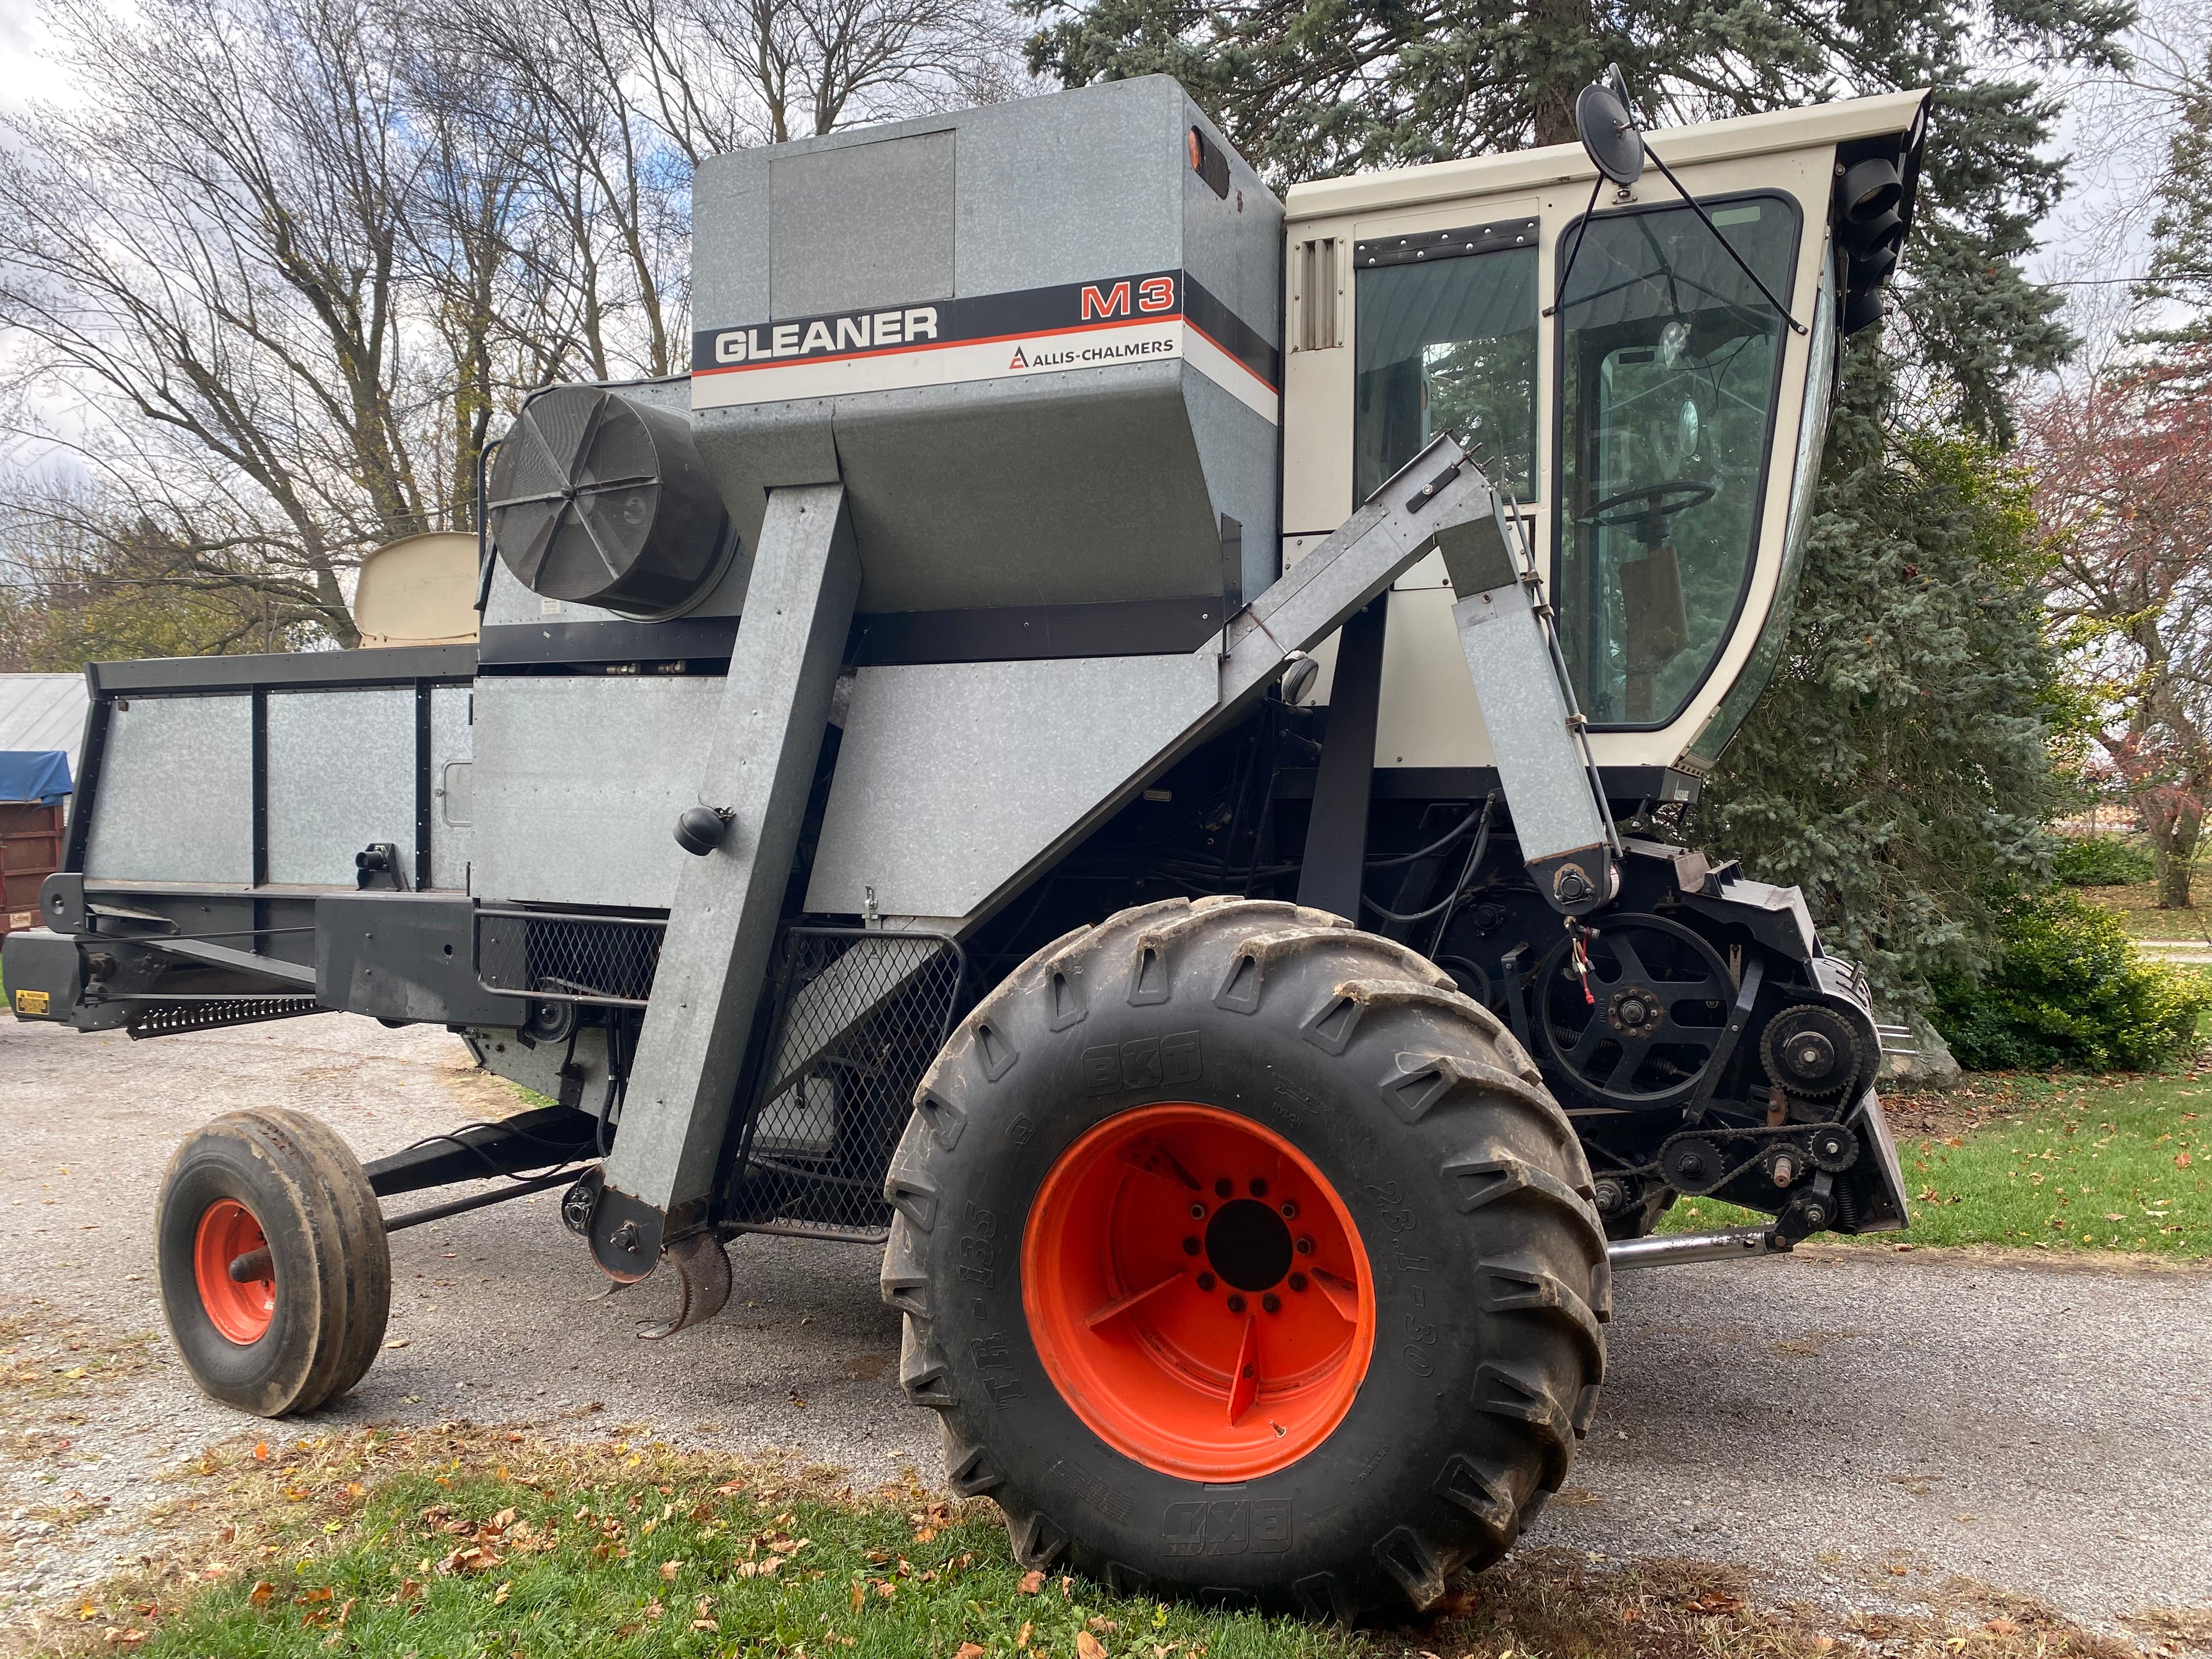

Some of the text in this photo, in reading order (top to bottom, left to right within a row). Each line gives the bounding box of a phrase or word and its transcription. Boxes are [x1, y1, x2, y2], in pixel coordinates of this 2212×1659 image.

[1081, 276, 1174, 320] M3
[715, 307, 938, 364] GLEANER
[1032, 339, 1174, 368] ALLIS-CHALMERS
[1083, 1037, 1200, 1093] BKT
[1272, 1102, 1304, 1127] NYLON
[1162, 1503, 1289, 1550] BKT
